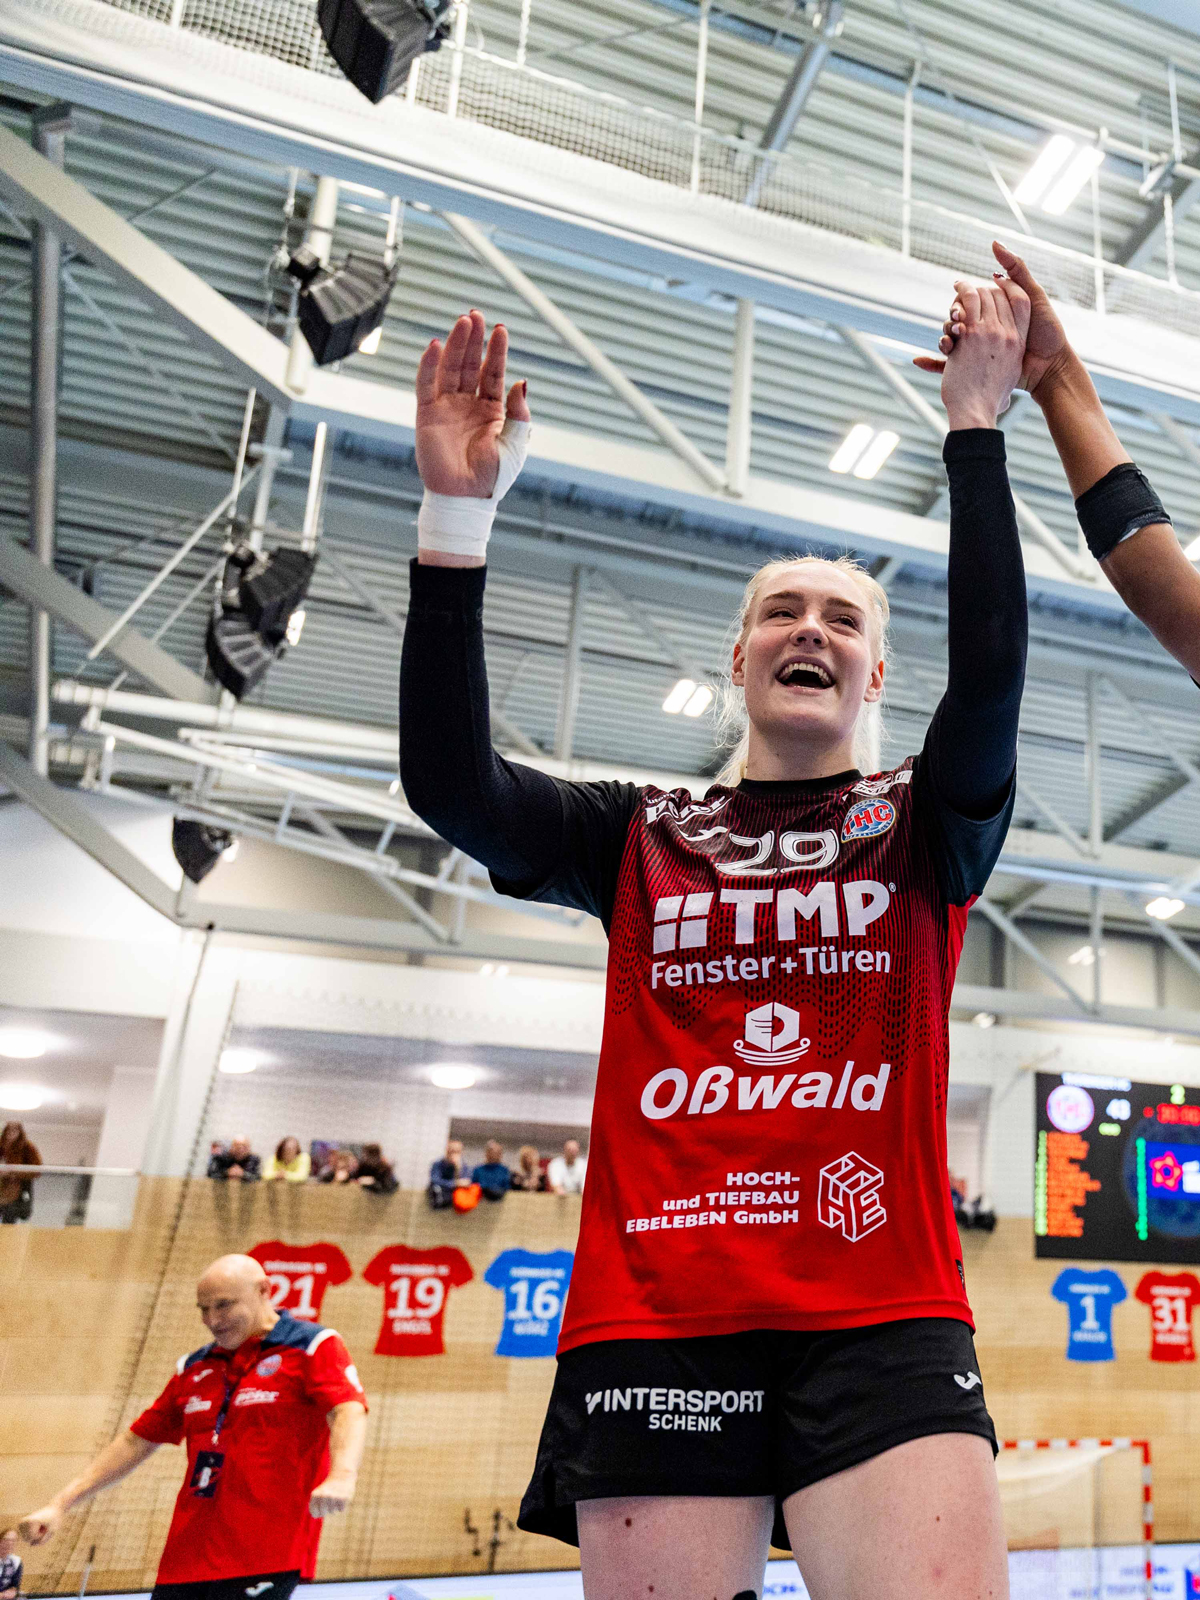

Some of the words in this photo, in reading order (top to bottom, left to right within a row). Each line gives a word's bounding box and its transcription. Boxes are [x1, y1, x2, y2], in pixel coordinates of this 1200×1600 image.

[844, 804, 892, 836] THC
[715, 828, 840, 877] 29
[640, 1060, 891, 1120] Oßwald
[726, 1171, 800, 1186] HOCH-
[662, 1194, 701, 1211] und
[705, 1190, 800, 1206] TIEFBAU
[626, 1211, 727, 1233] EBELEBEN
[733, 1209, 799, 1225] GmbH
[268, 1273, 317, 1318] 21
[387, 1277, 445, 1319] 19
[508, 1279, 561, 1320] 16
[1079, 1295, 1100, 1330] 1
[1152, 1297, 1189, 1331] 31
[604, 1387, 765, 1414] INTERSPORT
[648, 1413, 722, 1432] SCHENK
